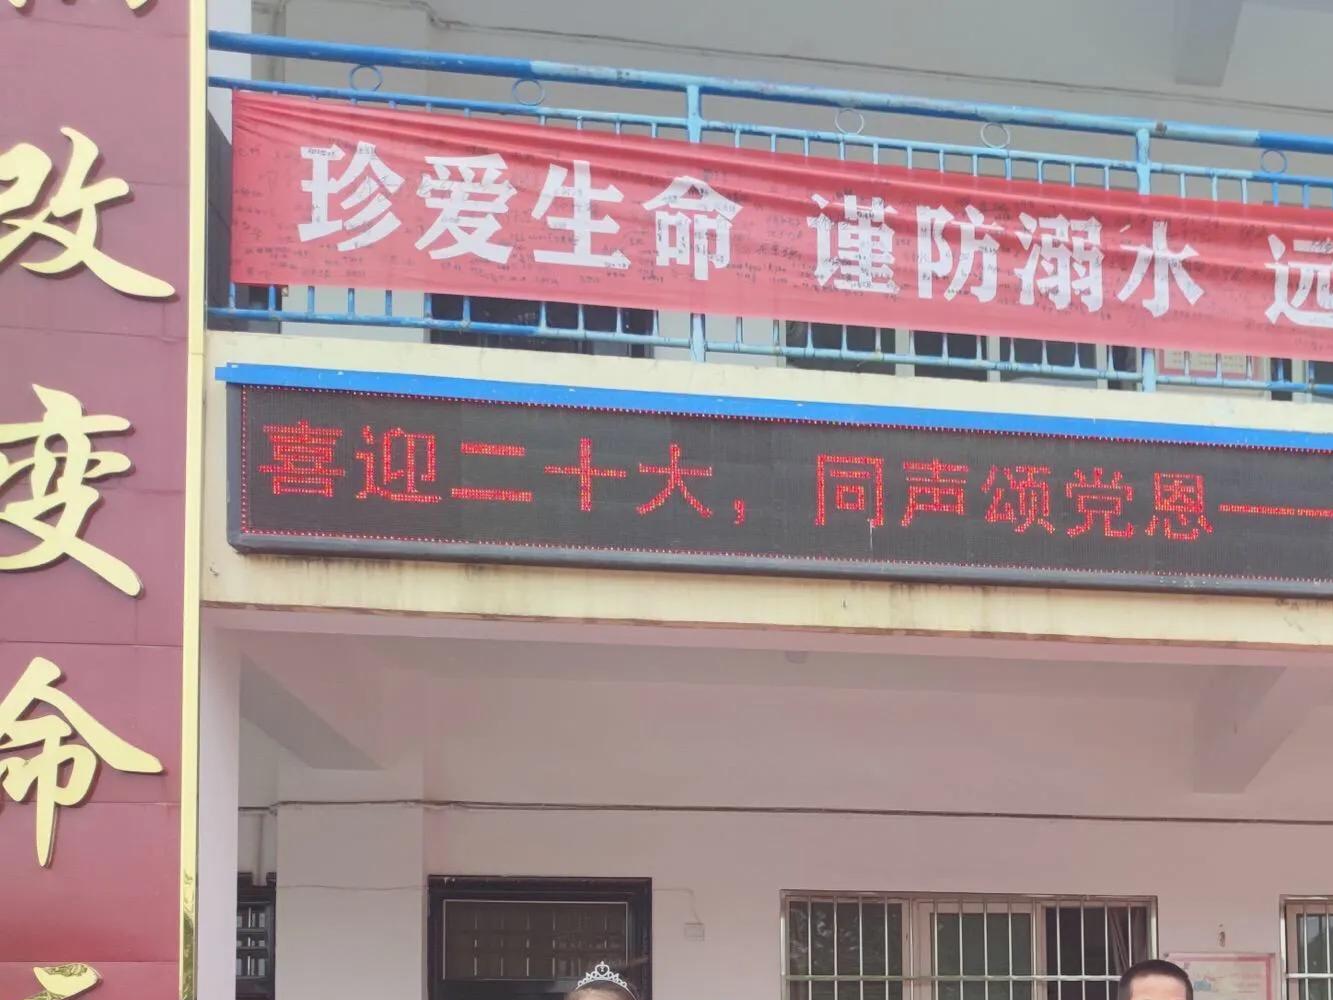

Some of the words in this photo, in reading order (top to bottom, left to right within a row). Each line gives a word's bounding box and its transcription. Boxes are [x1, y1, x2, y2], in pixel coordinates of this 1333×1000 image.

[297, 141, 743, 281] 珍爱生命
[806, 193, 1205, 318] 谨防溺水
